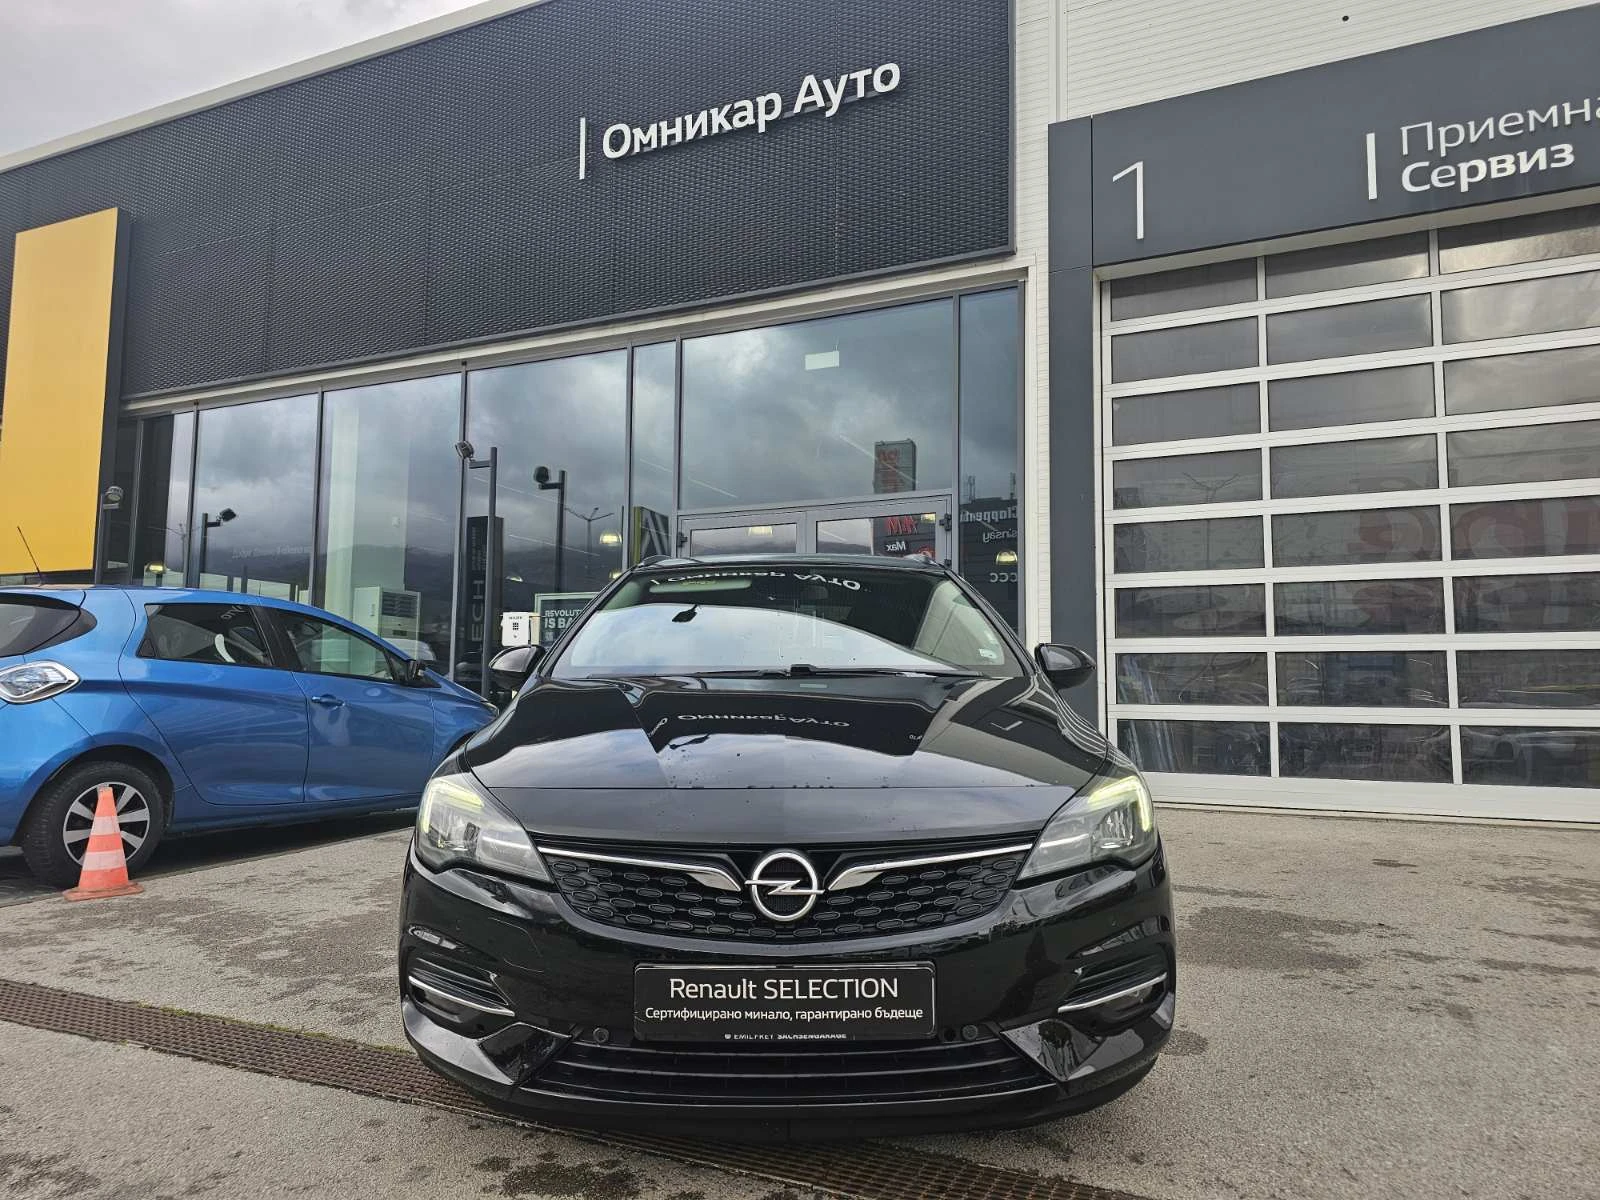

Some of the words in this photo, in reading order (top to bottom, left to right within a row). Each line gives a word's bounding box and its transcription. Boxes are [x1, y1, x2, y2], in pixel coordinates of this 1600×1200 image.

[602, 92, 782, 159] Омникар
[793, 62, 900, 117] Ауто
[1400, 97, 1600, 157] Приемн
[1401, 143, 1575, 193] Сервиз
[1112, 161, 1144, 240] 1
[544, 617, 556, 629] IS
[669, 978, 757, 999] Renault
[763, 978, 898, 999] SELECTION
[645, 1007, 742, 1021] Сертифицирано
[744, 1010, 793, 1021] минало,
[795, 1009, 872, 1022] гарантирано
[874, 1007, 923, 1020] бъдеще
